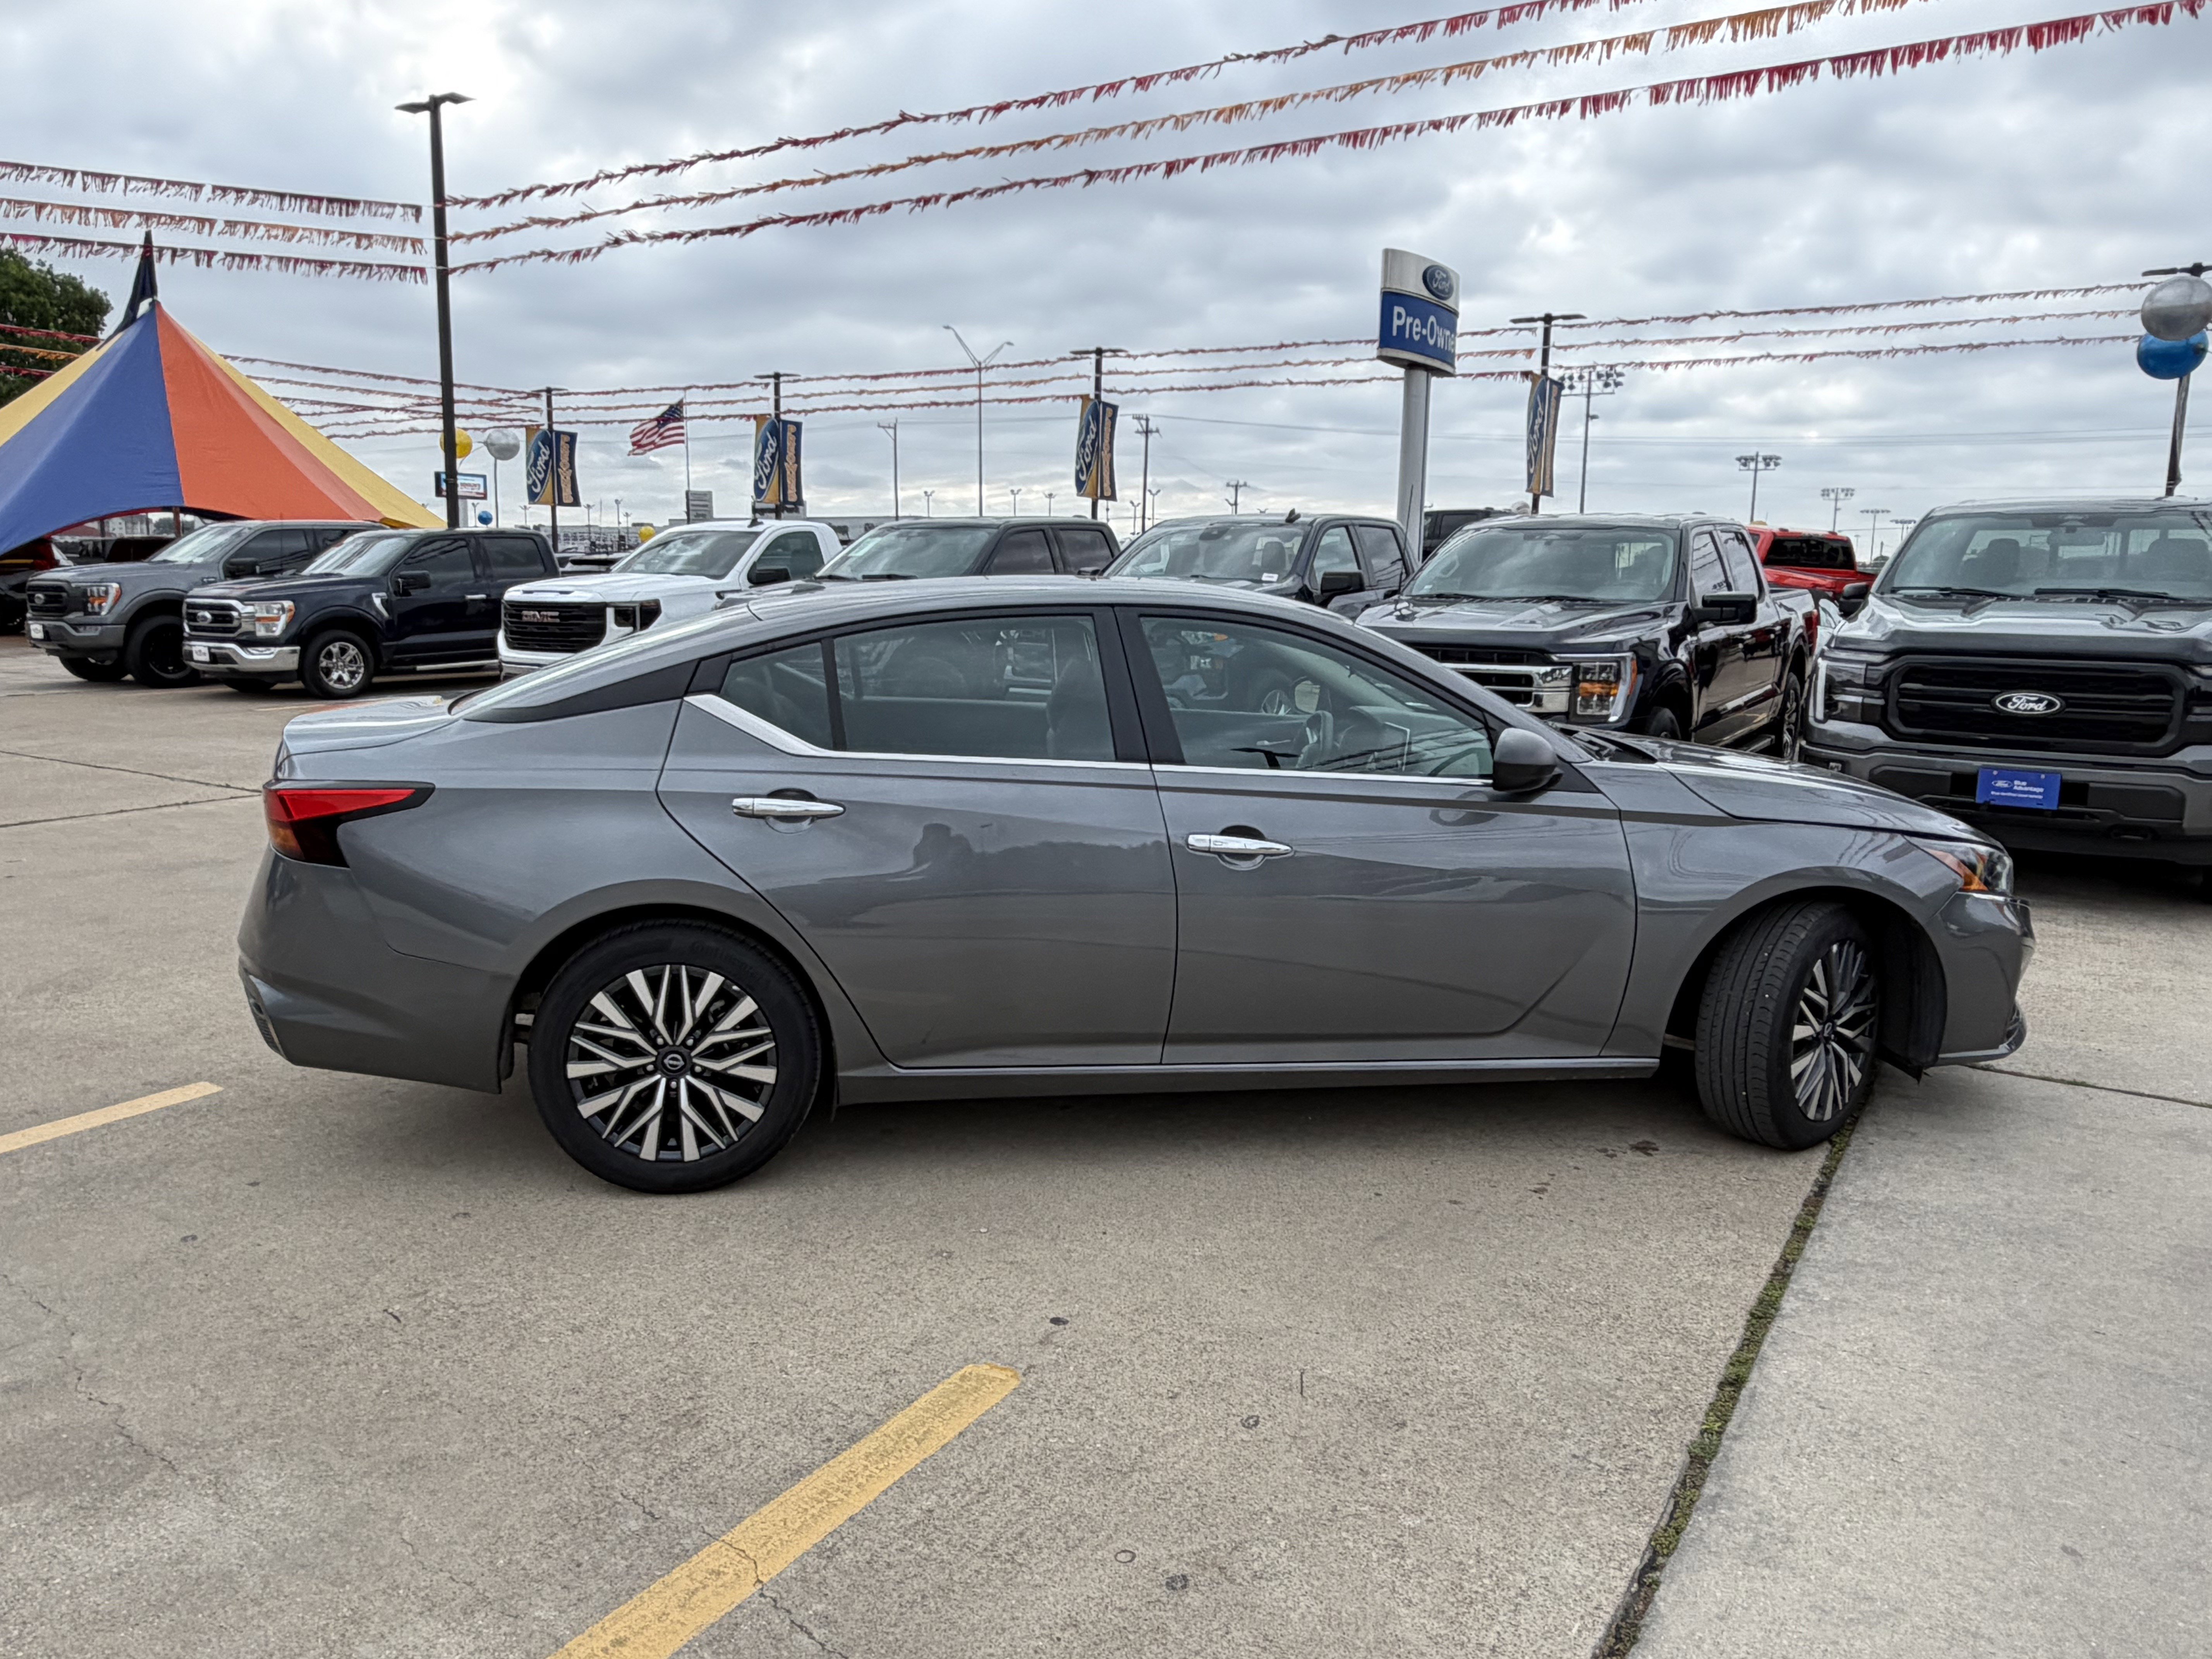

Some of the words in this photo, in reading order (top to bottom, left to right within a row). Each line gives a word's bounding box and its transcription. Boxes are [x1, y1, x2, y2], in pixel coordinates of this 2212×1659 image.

[1432, 270, 1450, 292] Ford
[1392, 306, 1455, 353] Pre-Owne
[527, 441, 550, 493] Ford
[755, 431, 777, 489] Ford
[1076, 414, 1097, 481] Ford
[521, 610, 560, 623] GMC
[2008, 696, 2048, 711] Ford
